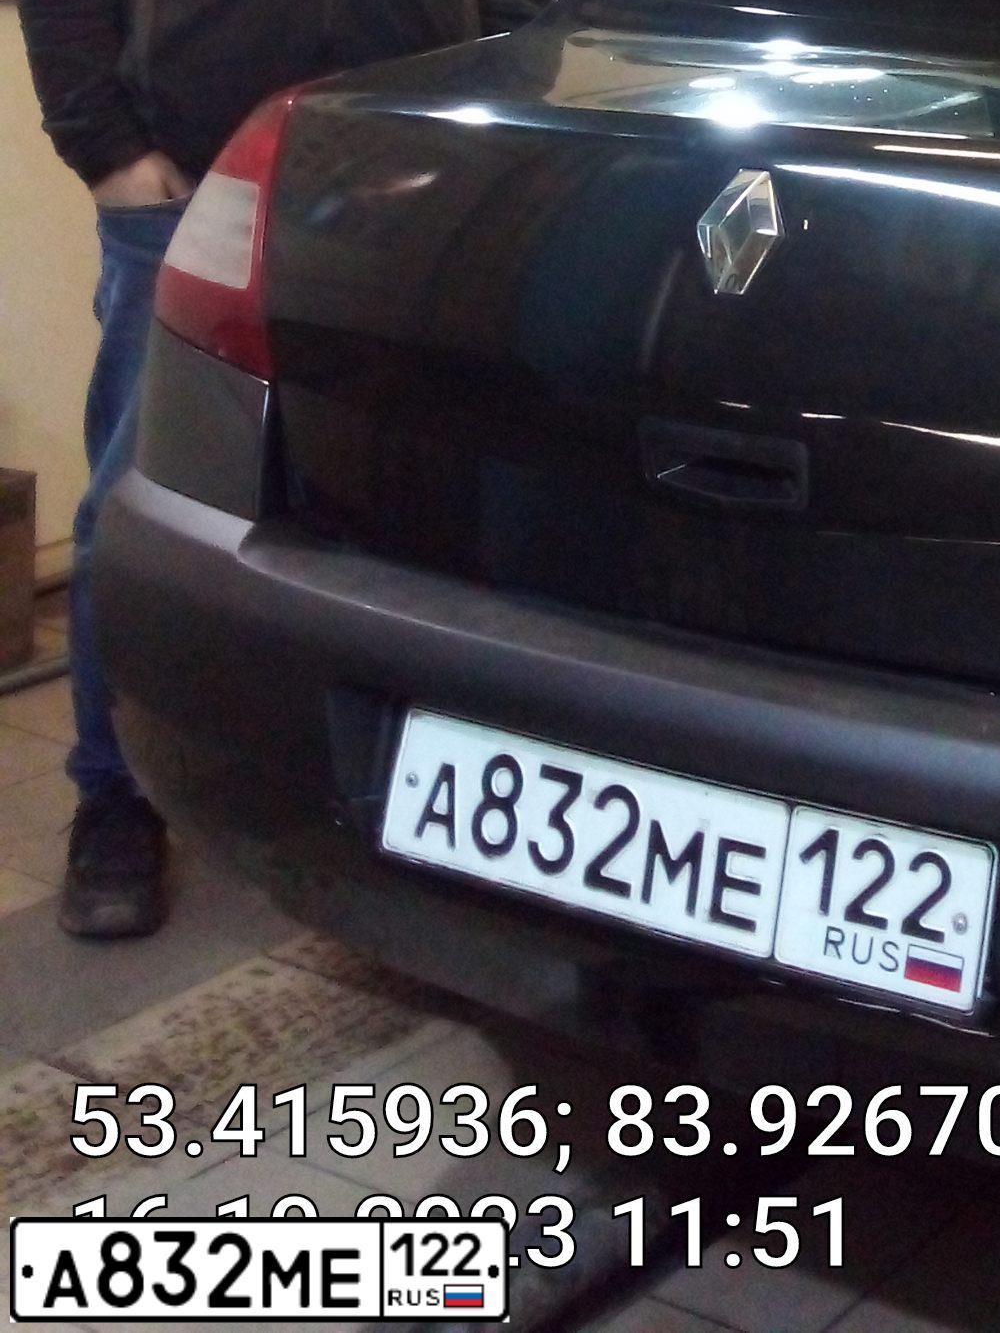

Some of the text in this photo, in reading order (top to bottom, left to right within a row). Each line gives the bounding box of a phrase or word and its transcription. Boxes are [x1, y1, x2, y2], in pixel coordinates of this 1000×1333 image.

[413, 753, 952, 944] А832МЕ 122
[823, 925, 901, 973] RUS
